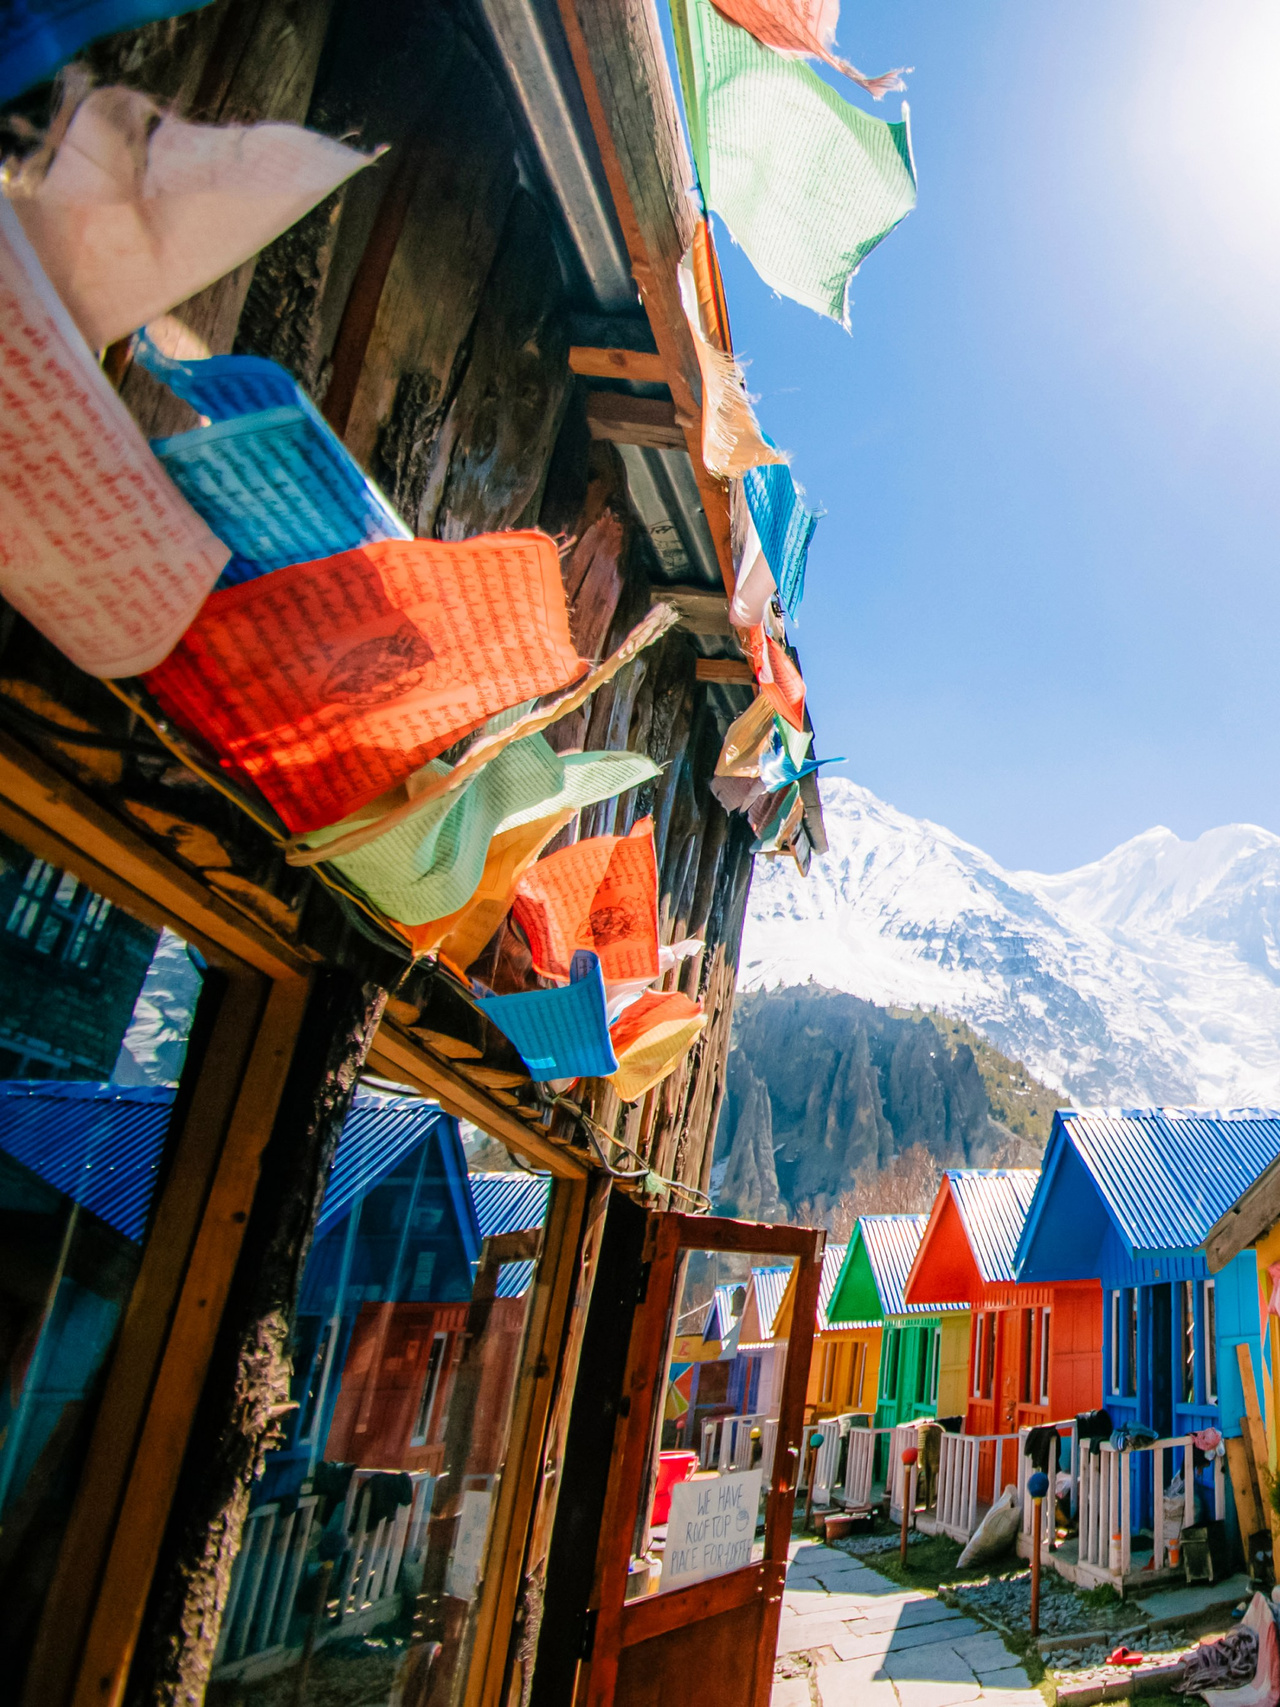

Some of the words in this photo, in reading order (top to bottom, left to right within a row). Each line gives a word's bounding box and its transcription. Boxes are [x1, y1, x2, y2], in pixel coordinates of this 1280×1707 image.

[697, 1489, 711, 1515] WE
[718, 1484, 743, 1511] HAVE
[671, 1547, 698, 1575] PLACE
